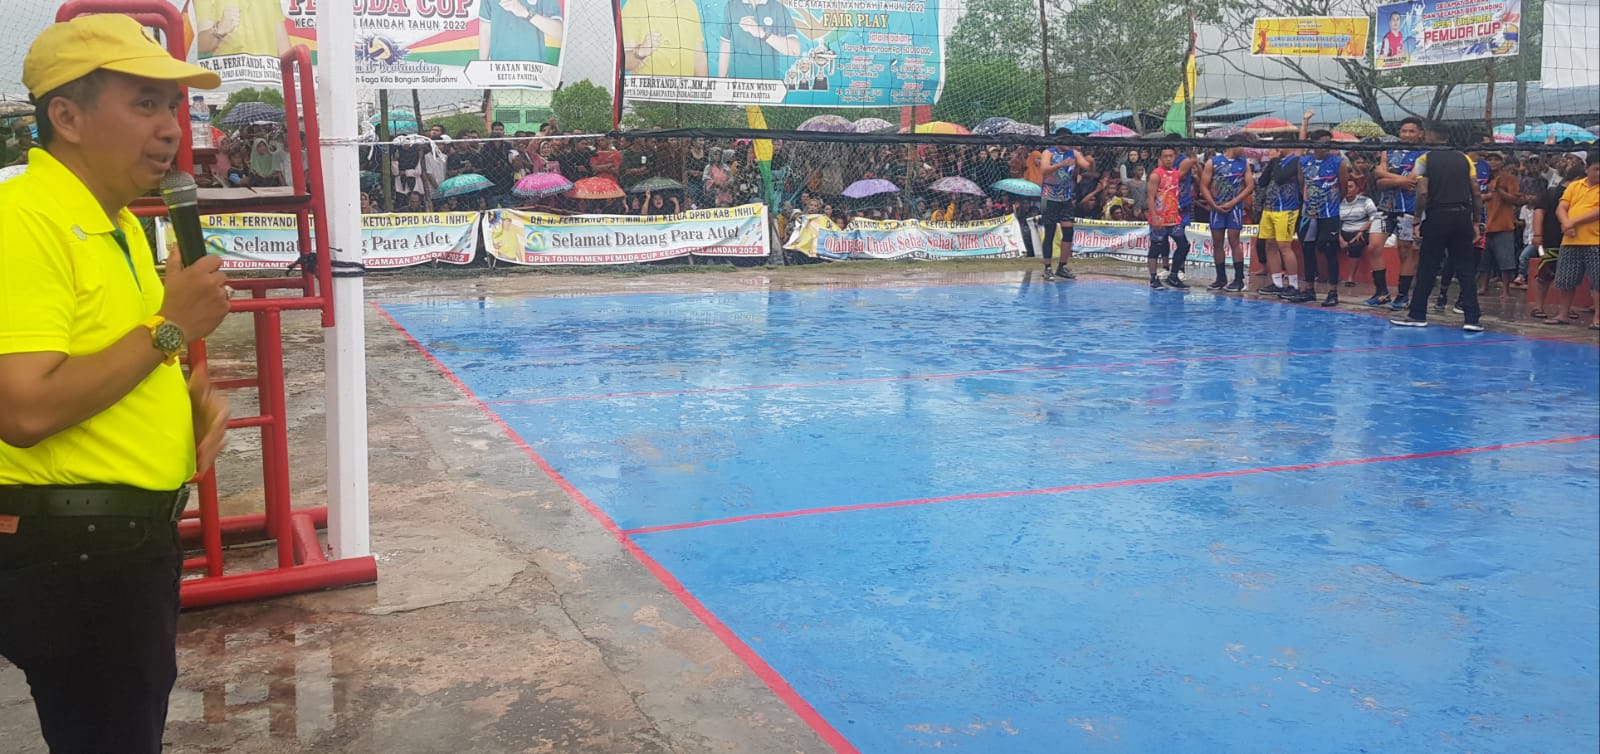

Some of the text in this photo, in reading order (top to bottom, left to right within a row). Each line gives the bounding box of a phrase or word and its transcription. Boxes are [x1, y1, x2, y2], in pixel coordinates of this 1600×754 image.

[880, 2, 905, 10] TAHUN
[907, 4, 924, 12] 2022
[1436, 9, 1463, 18] SELAMAT
[360, 18, 404, 30] MANDAH
[407, 19, 439, 30] TAHUN
[443, 20, 466, 30] 2022
[823, 13, 888, 28] FAIR PLAY
[1424, 21, 1502, 43] PEMUDA CUP
[495, 63, 521, 72] WAYAN
[522, 63, 544, 73] WISNU
[394, 76, 420, 84] Bangun
[732, 82, 755, 91] WAYAN
[760, 83, 777, 92] WISNU
[689, 210, 711, 220] DPRD
[734, 207, 757, 217] INHIL
[209, 216, 226, 226] DR.
[229, 216, 239, 226] H.
[363, 216, 393, 227] KETUA
[395, 215, 419, 226] DPRD
[422, 215, 443, 225] KAB.
[445, 215, 469, 224] INHIL
[372, 235, 409, 251] Para
[413, 232, 450, 248] Atlet
[552, 225, 739, 248] Selamat Datang Para Atlet
[957, 233, 979, 250] Milik
[983, 232, 1004, 248] Kita
[1073, 230, 1124, 250] Olahraga
[363, 256, 411, 266] ECAMATAN
[447, 254, 465, 262] 2022
[528, 255, 550, 263] OPEN
[552, 255, 602, 263] TOURNAMEN
[604, 253, 639, 263] PEMUDA
[640, 252, 657, 261] CUP
[739, 246, 759, 254] 2022
